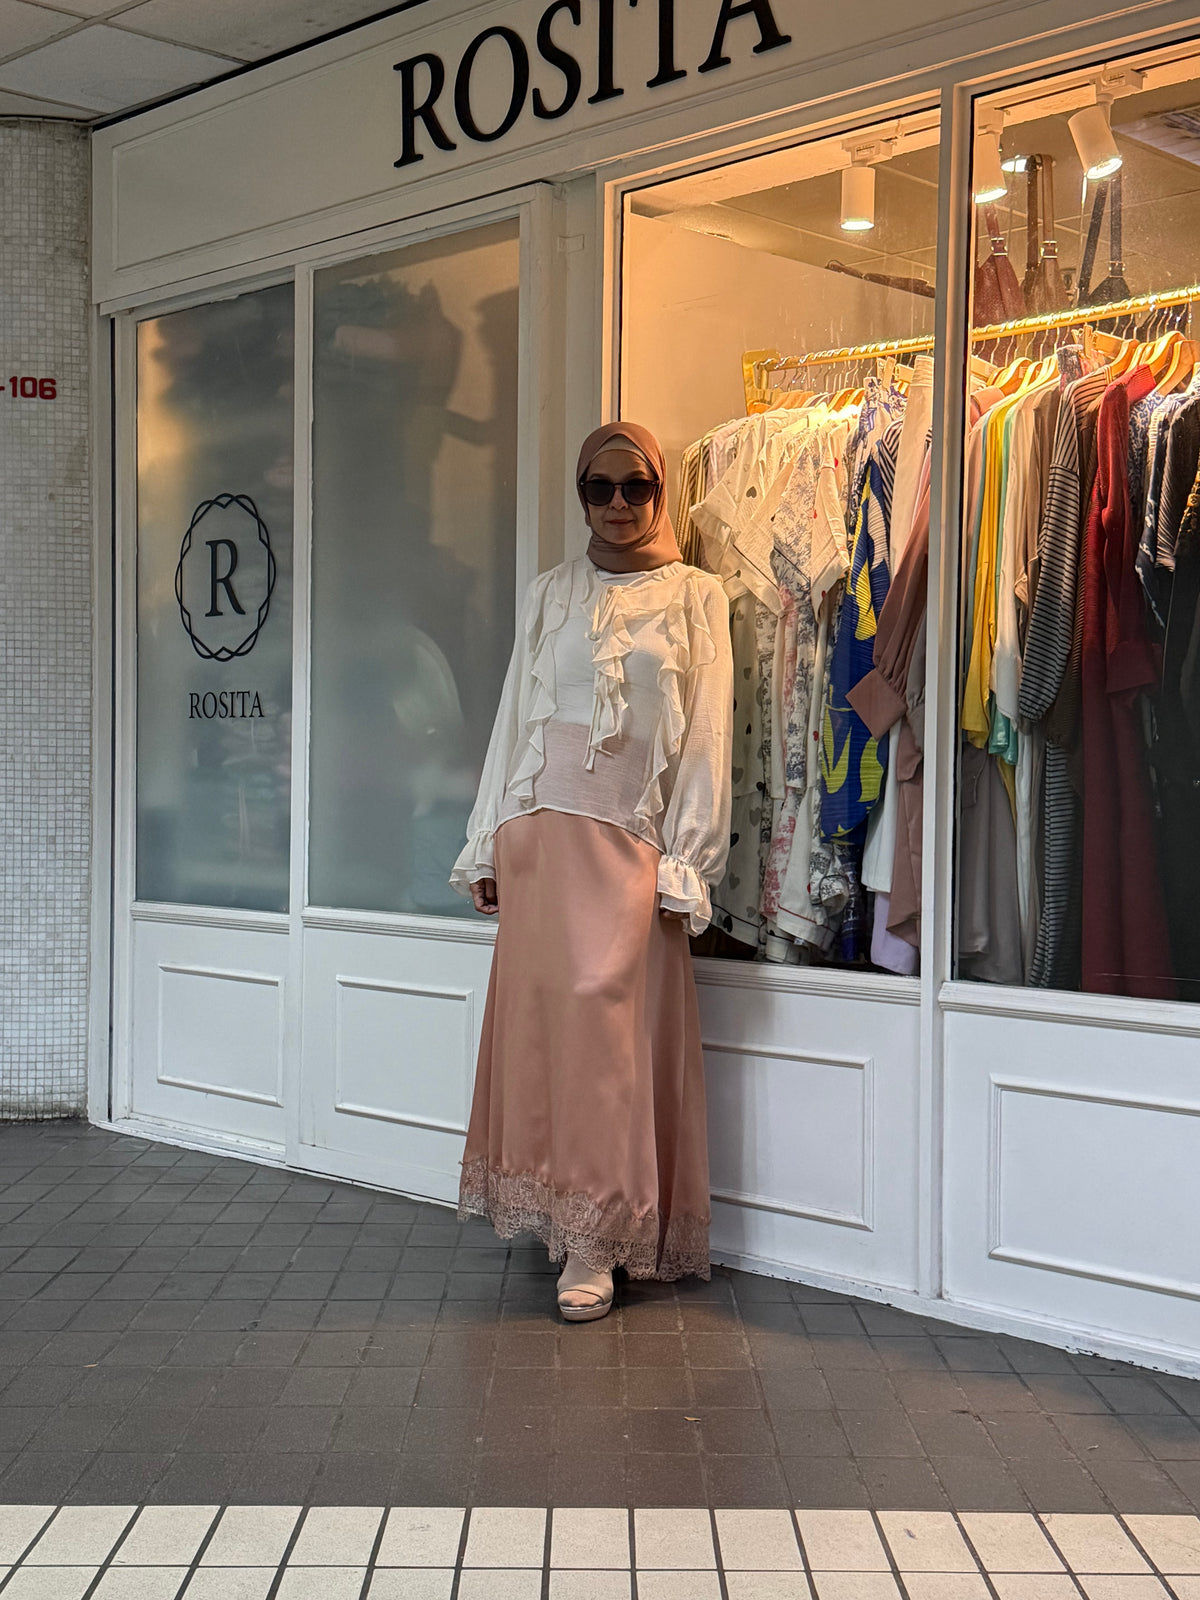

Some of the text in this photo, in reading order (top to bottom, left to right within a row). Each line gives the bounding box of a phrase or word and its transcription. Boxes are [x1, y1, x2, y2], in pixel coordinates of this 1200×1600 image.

[393, 0, 792, 168] ROSITA
[205, 539, 246, 617] R
[188, 691, 264, 719] ROSITA
